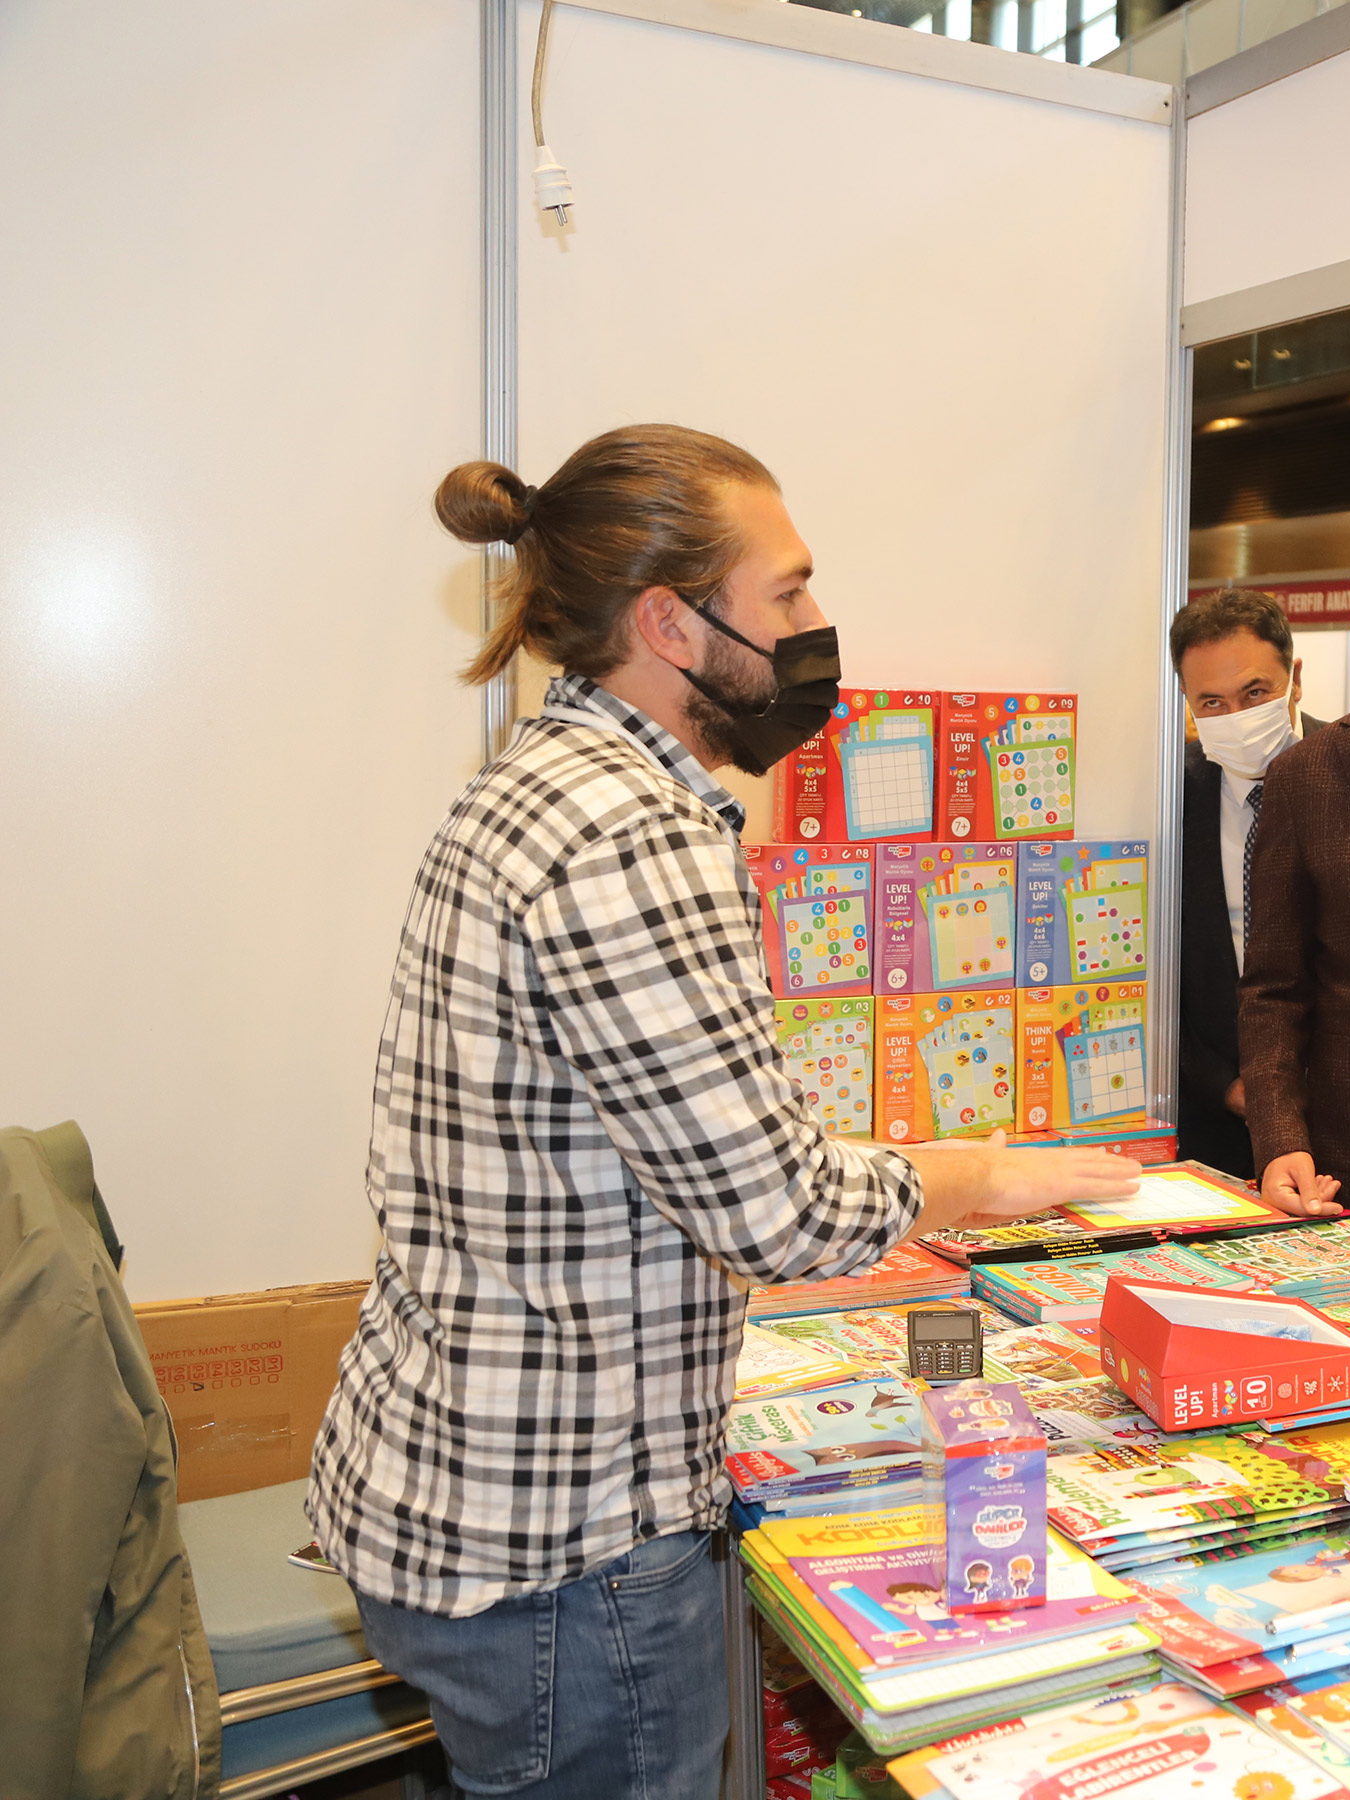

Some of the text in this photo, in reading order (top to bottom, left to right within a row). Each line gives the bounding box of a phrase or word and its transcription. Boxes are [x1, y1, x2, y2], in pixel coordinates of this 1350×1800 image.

[917, 694, 931, 705] 10
[950, 732, 976, 742] LEVEL
[802, 741, 820, 750] UP!
[954, 743, 971, 753] UP!
[803, 821, 818, 833] 7+
[954, 821, 968, 832] 7+
[886, 884, 912, 894] LEVEL
[1028, 881, 1052, 891] LEVEL
[890, 894, 907, 905] UP!
[1032, 891, 1048, 901] UP!
[891, 934, 905, 942] 4x4
[1033, 966, 1046, 977] 5+
[891, 973, 905, 984] 6+
[1025, 1026, 1052, 1036] THINK
[886, 1036, 912, 1047] LEVEL
[1030, 1036, 1047, 1046] UP!
[890, 1047, 907, 1057] UP!
[1031, 1073, 1045, 1081] 3x3
[891, 1085, 906, 1094] 4x4
[1031, 1111, 1045, 1122] 3+
[892, 1124, 906, 1135] 3+
[1020, 1263, 1105, 1303] JUMBO
[866, 1321, 906, 1347] Hidden
[199, 1345, 237, 1356] MANTIK
[240, 1340, 282, 1352] SUDOKU
[1246, 1379, 1267, 1409] 10
[1174, 1384, 1189, 1426] LEVEL
[1190, 1389, 1205, 1418] UP!
[1211, 1381, 1219, 1419] Apartman
[734, 1413, 768, 1442] Çiftlik
[808, 1555, 886, 1570] ALGORİTMA
[814, 1563, 886, 1576] GELİŞTİRME
[1056, 1740, 1173, 1788] EĞLENCELİ
[1057, 1748, 1200, 1800] LABİRENTLER
